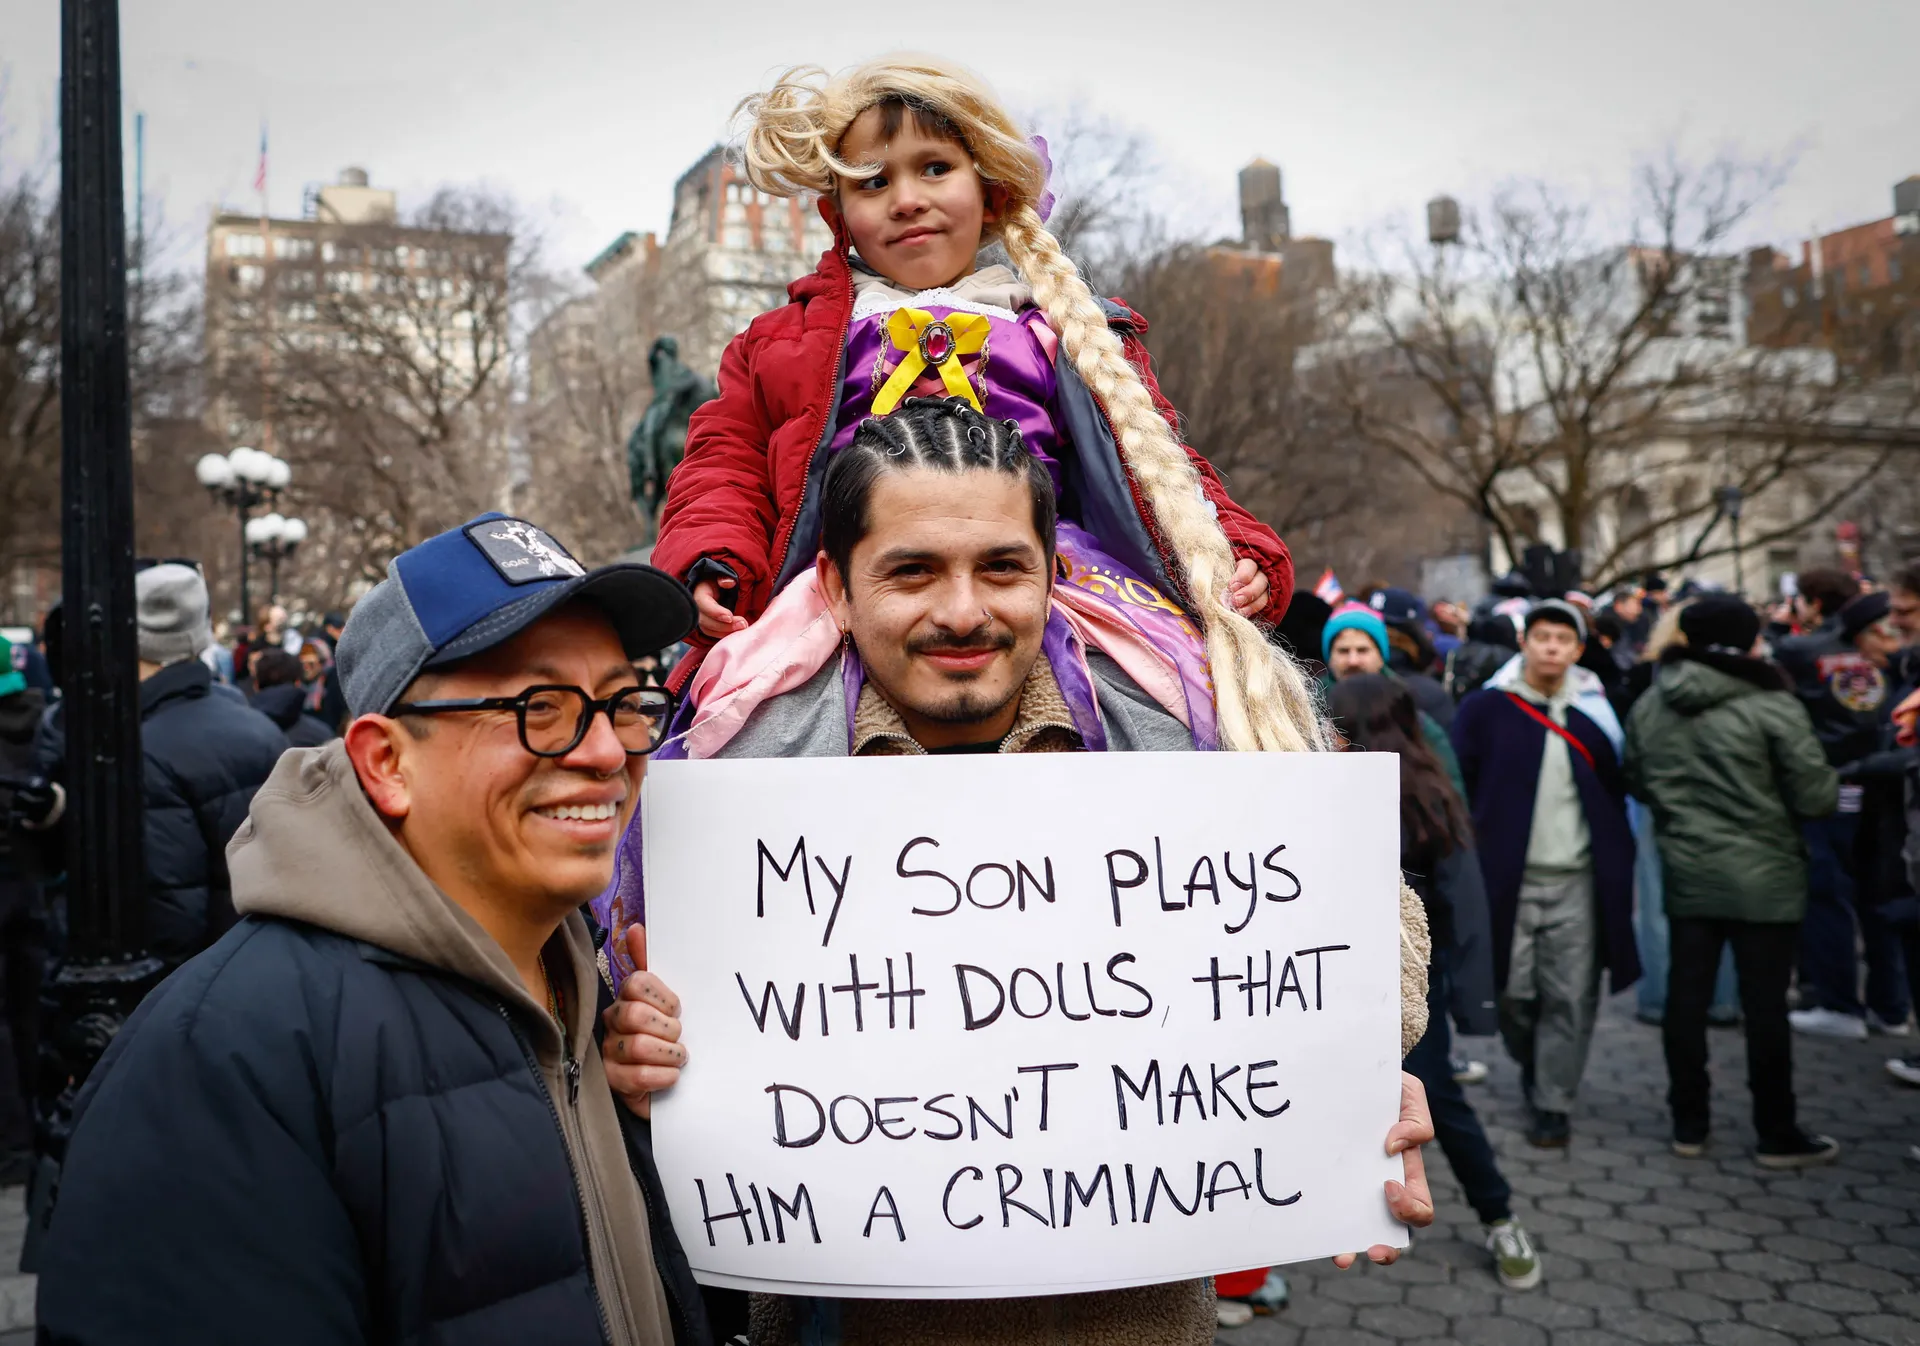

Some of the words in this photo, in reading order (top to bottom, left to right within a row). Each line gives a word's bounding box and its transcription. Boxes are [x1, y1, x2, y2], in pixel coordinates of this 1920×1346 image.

[501, 557, 530, 569] GOAT
[896, 836, 1056, 917] SON
[764, 1062, 1079, 1149] DOESN'T
[1111, 1059, 1291, 1131] MAKE
[694, 1172, 822, 1247] HIM
[862, 1185, 907, 1242] A
[942, 1148, 1303, 1230] CRIMINAL
